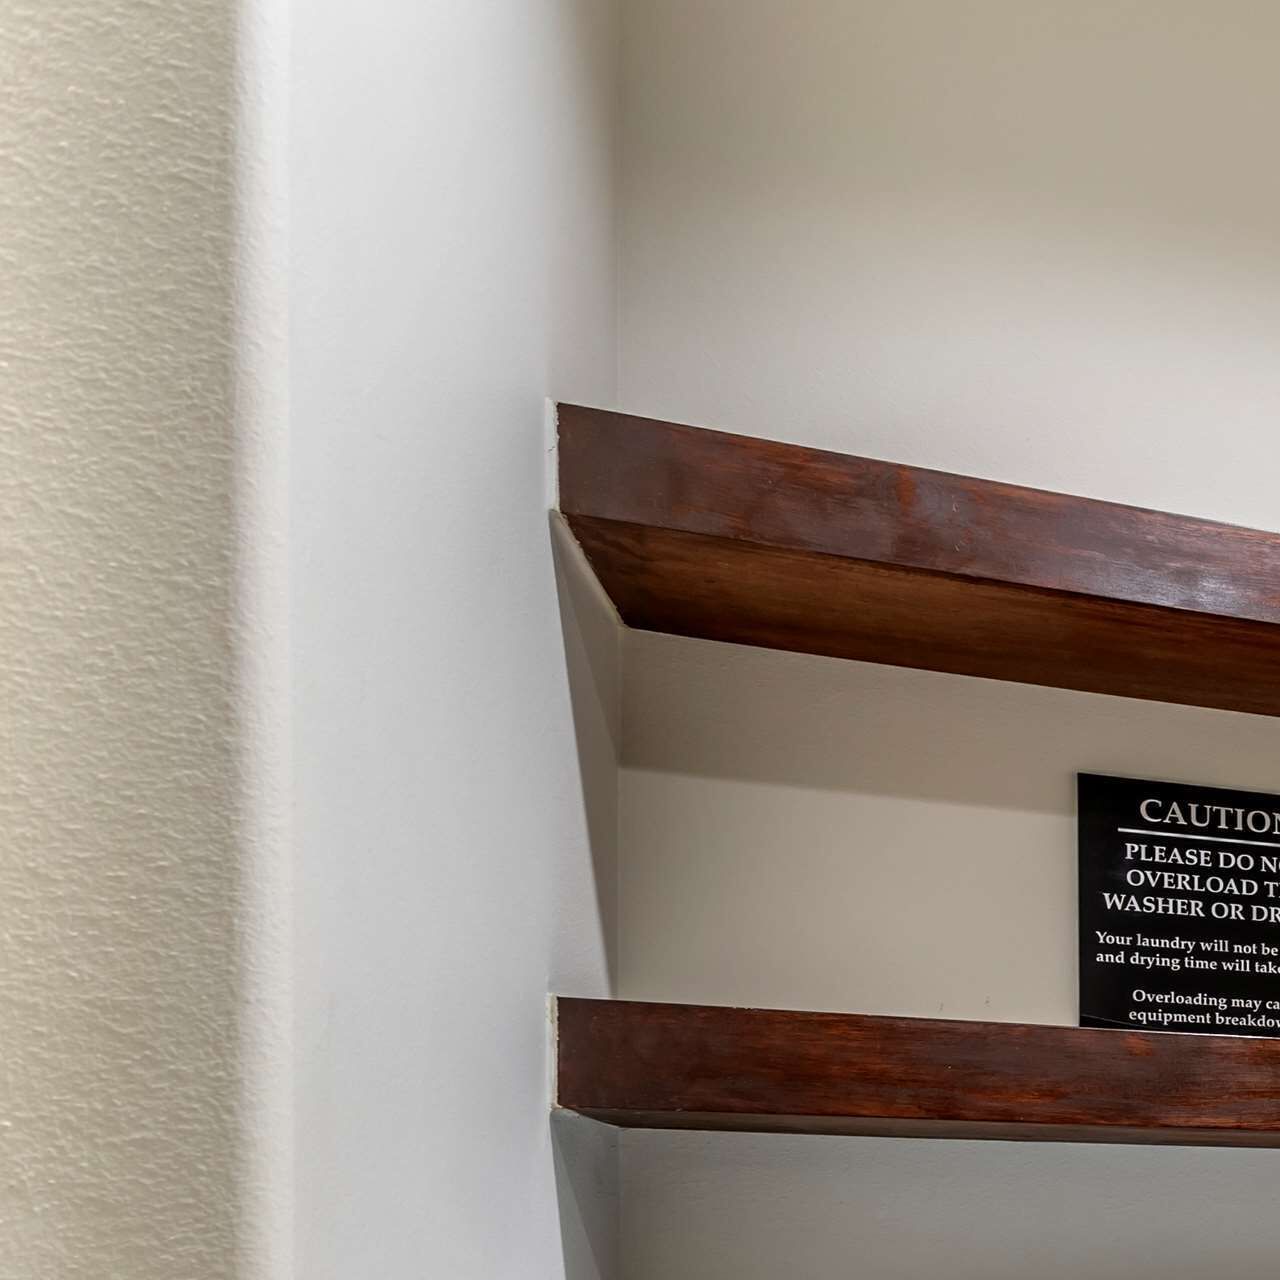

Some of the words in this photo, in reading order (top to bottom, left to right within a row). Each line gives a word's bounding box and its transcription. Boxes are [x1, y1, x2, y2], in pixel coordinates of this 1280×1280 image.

[1125, 843, 1213, 867] PLEASE
[1218, 851, 1254, 871] DO
[1126, 869, 1259, 896] OVERLOAD
[1103, 892, 1206, 918] WASHER
[1211, 902, 1245, 921] OR
[1096, 930, 1132, 946] Your
[1136, 934, 1196, 955] laundry
[1200, 938, 1229, 953] will
[1233, 941, 1258, 955] not
[1261, 942, 1278, 957] be
[1095, 951, 1125, 964] and
[1130, 953, 1181, 972] drying
[1184, 956, 1218, 971] time
[1221, 958, 1251, 973] will
[1132, 989, 1228, 1010] Overloading
[1231, 998, 1263, 1012] may
[1128, 1010, 1212, 1026] equipment
